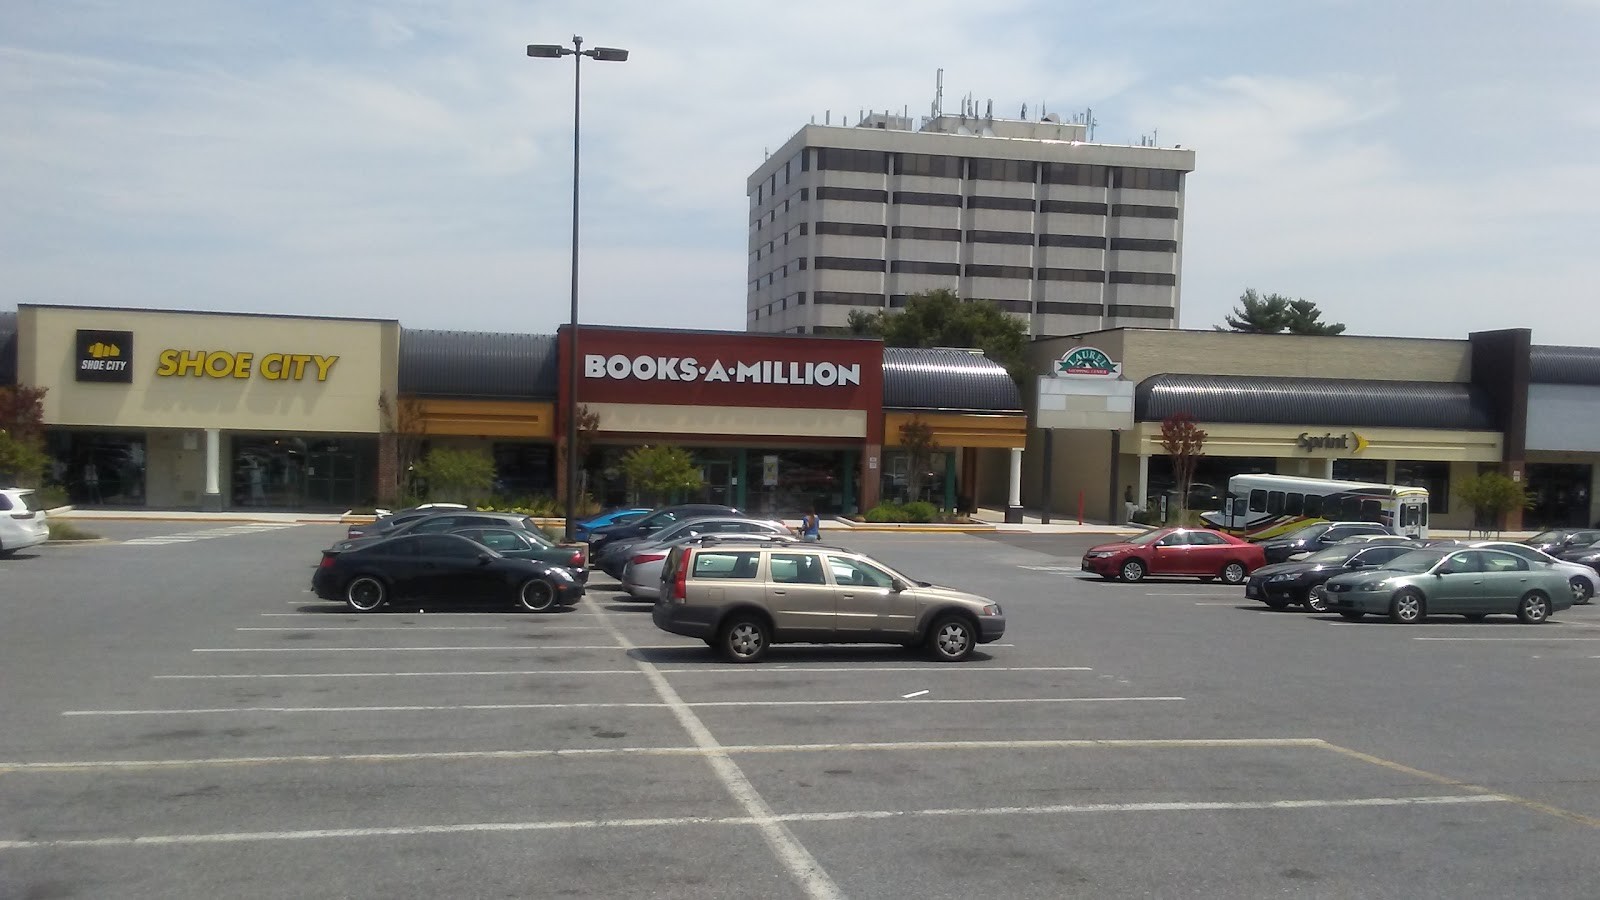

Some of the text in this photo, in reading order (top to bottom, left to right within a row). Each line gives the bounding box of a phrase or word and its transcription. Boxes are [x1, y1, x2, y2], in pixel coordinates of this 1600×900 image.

[81, 360, 127, 371] SHOE CITY
[157, 349, 340, 381] SHOE CITY
[1068, 351, 1107, 367] LAUREL
[1298, 433, 1348, 452] Sprint
